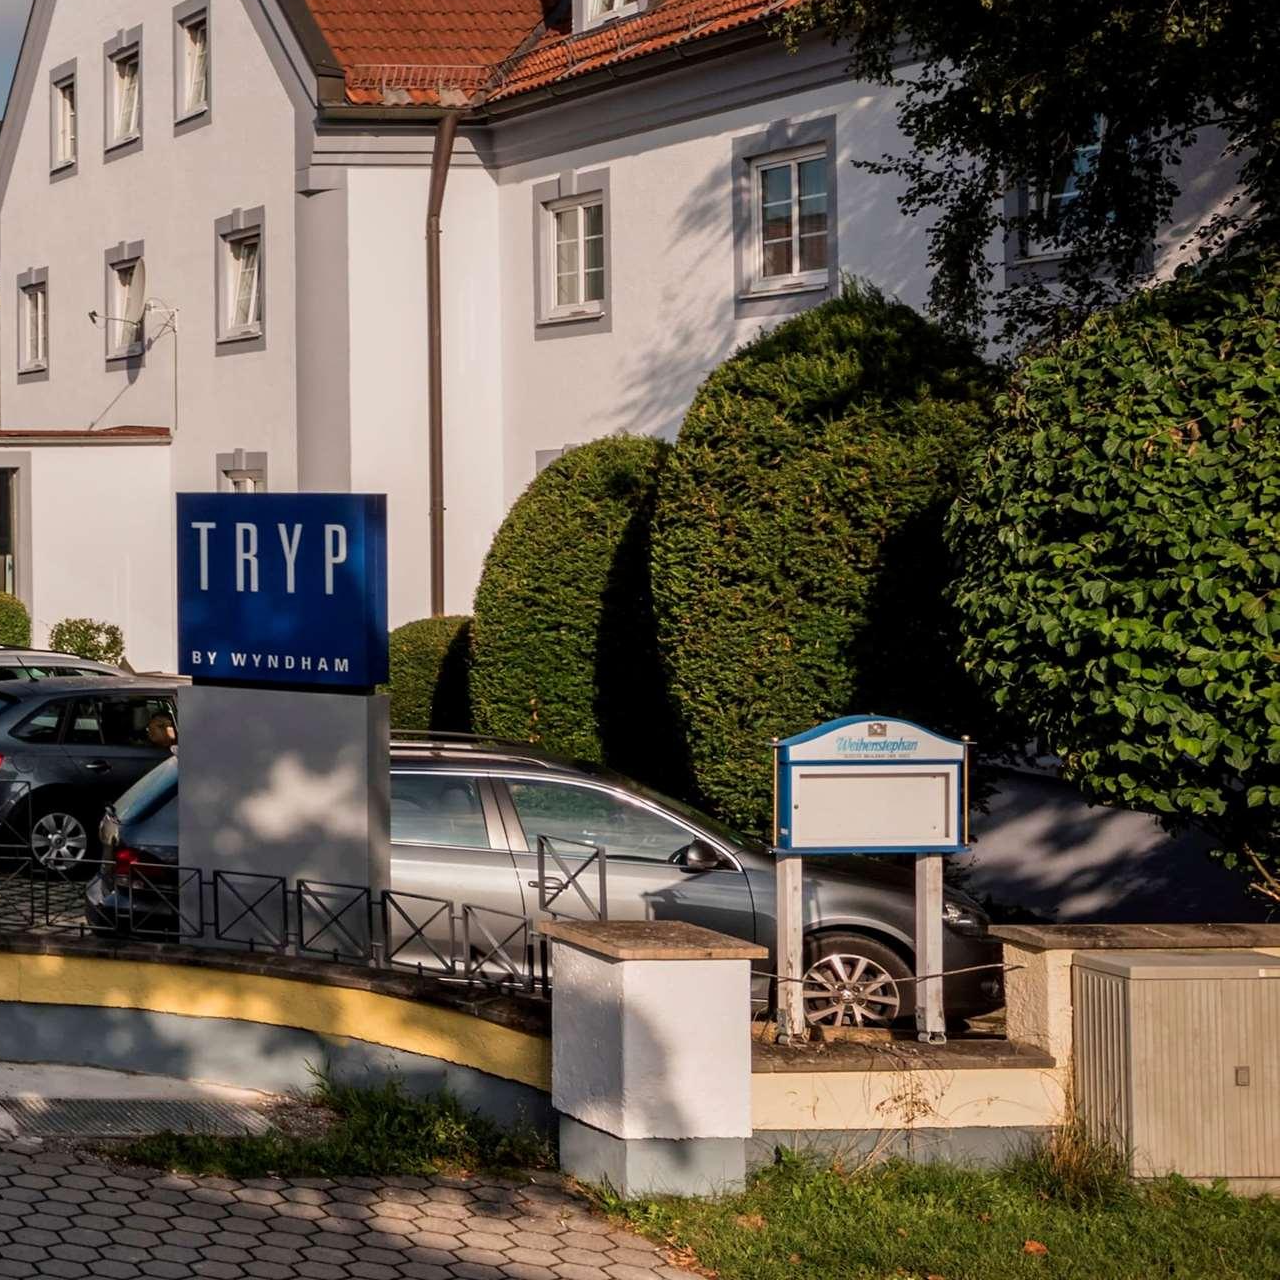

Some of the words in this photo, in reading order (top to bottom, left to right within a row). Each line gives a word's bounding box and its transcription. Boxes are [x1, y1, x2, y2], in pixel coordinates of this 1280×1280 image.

[191, 522, 347, 595] TRYP
[192, 651, 217, 665] BY
[231, 653, 349, 672] WYNDHAM
